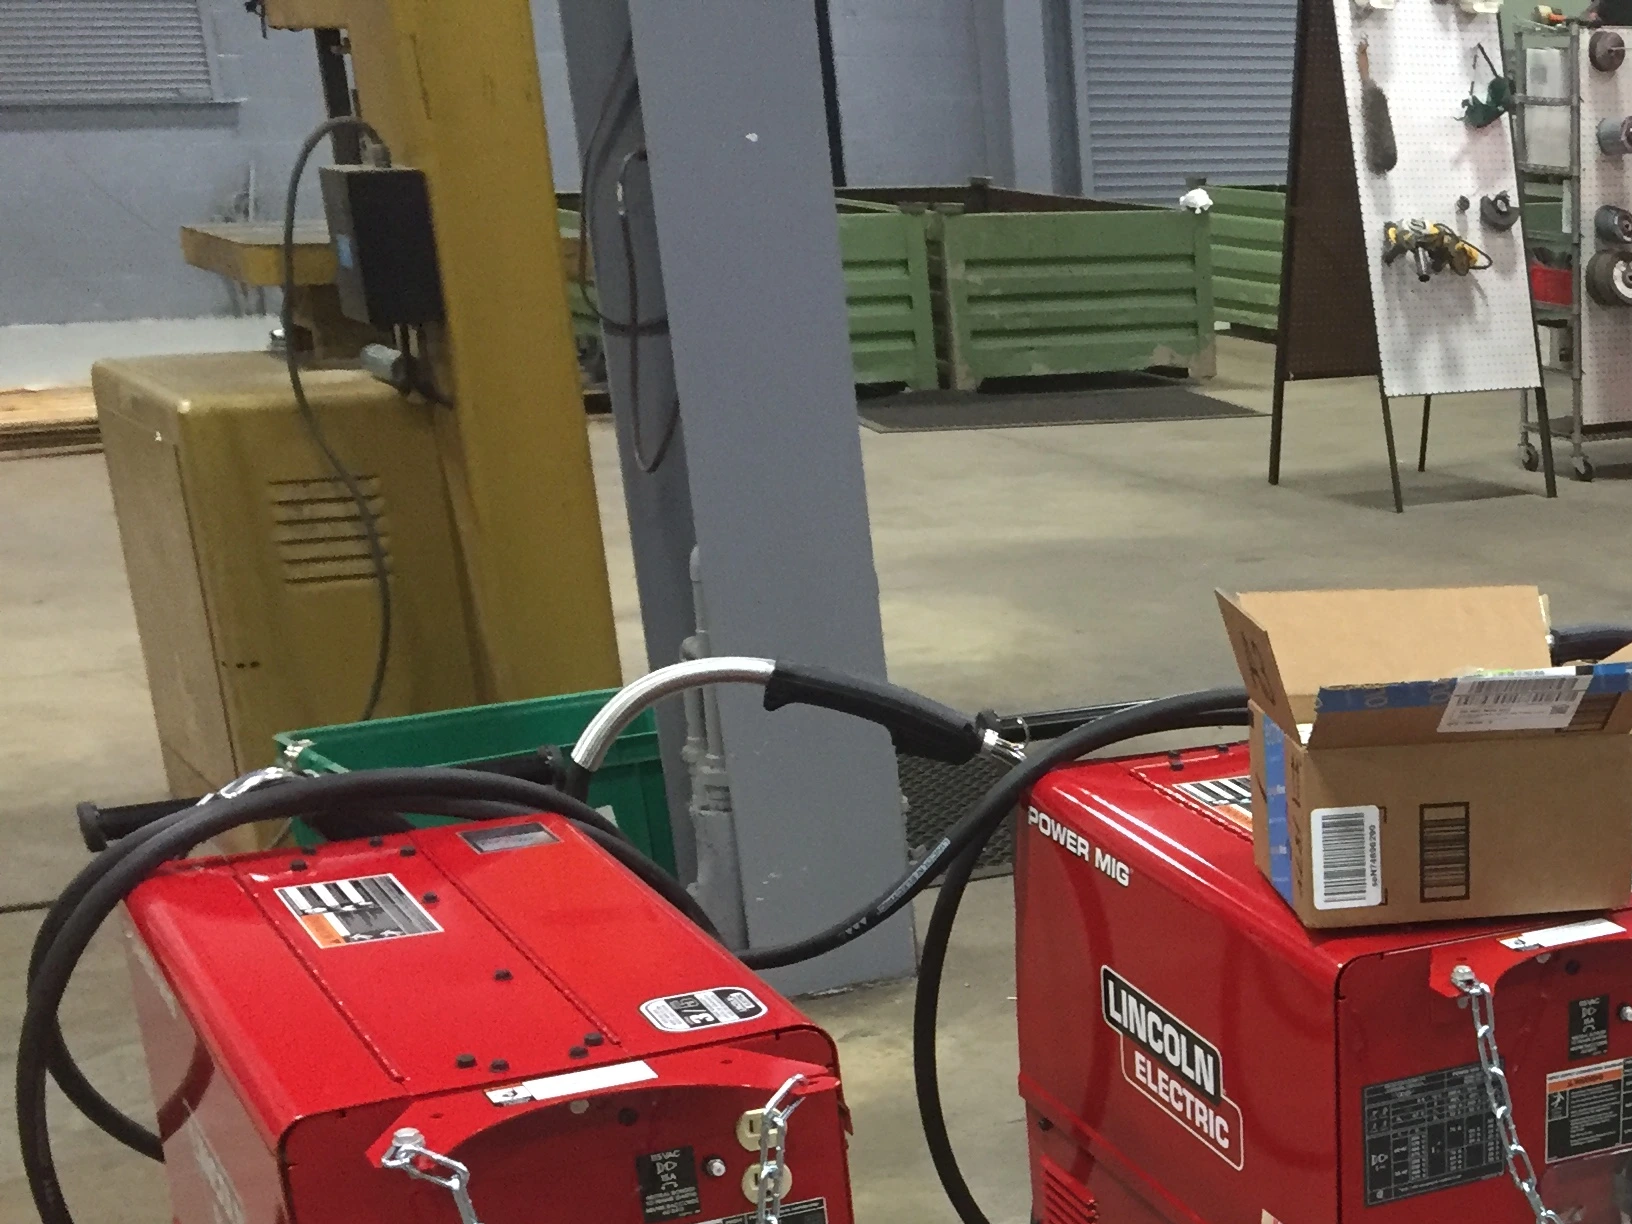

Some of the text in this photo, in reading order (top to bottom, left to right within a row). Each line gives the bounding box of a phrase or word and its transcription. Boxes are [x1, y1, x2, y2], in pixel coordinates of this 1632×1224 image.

[1028, 806, 1131, 888] POWER MIG
[1107, 978, 1217, 1097] LINCOLN
[1134, 1050, 1230, 1150] ELECTRIC
